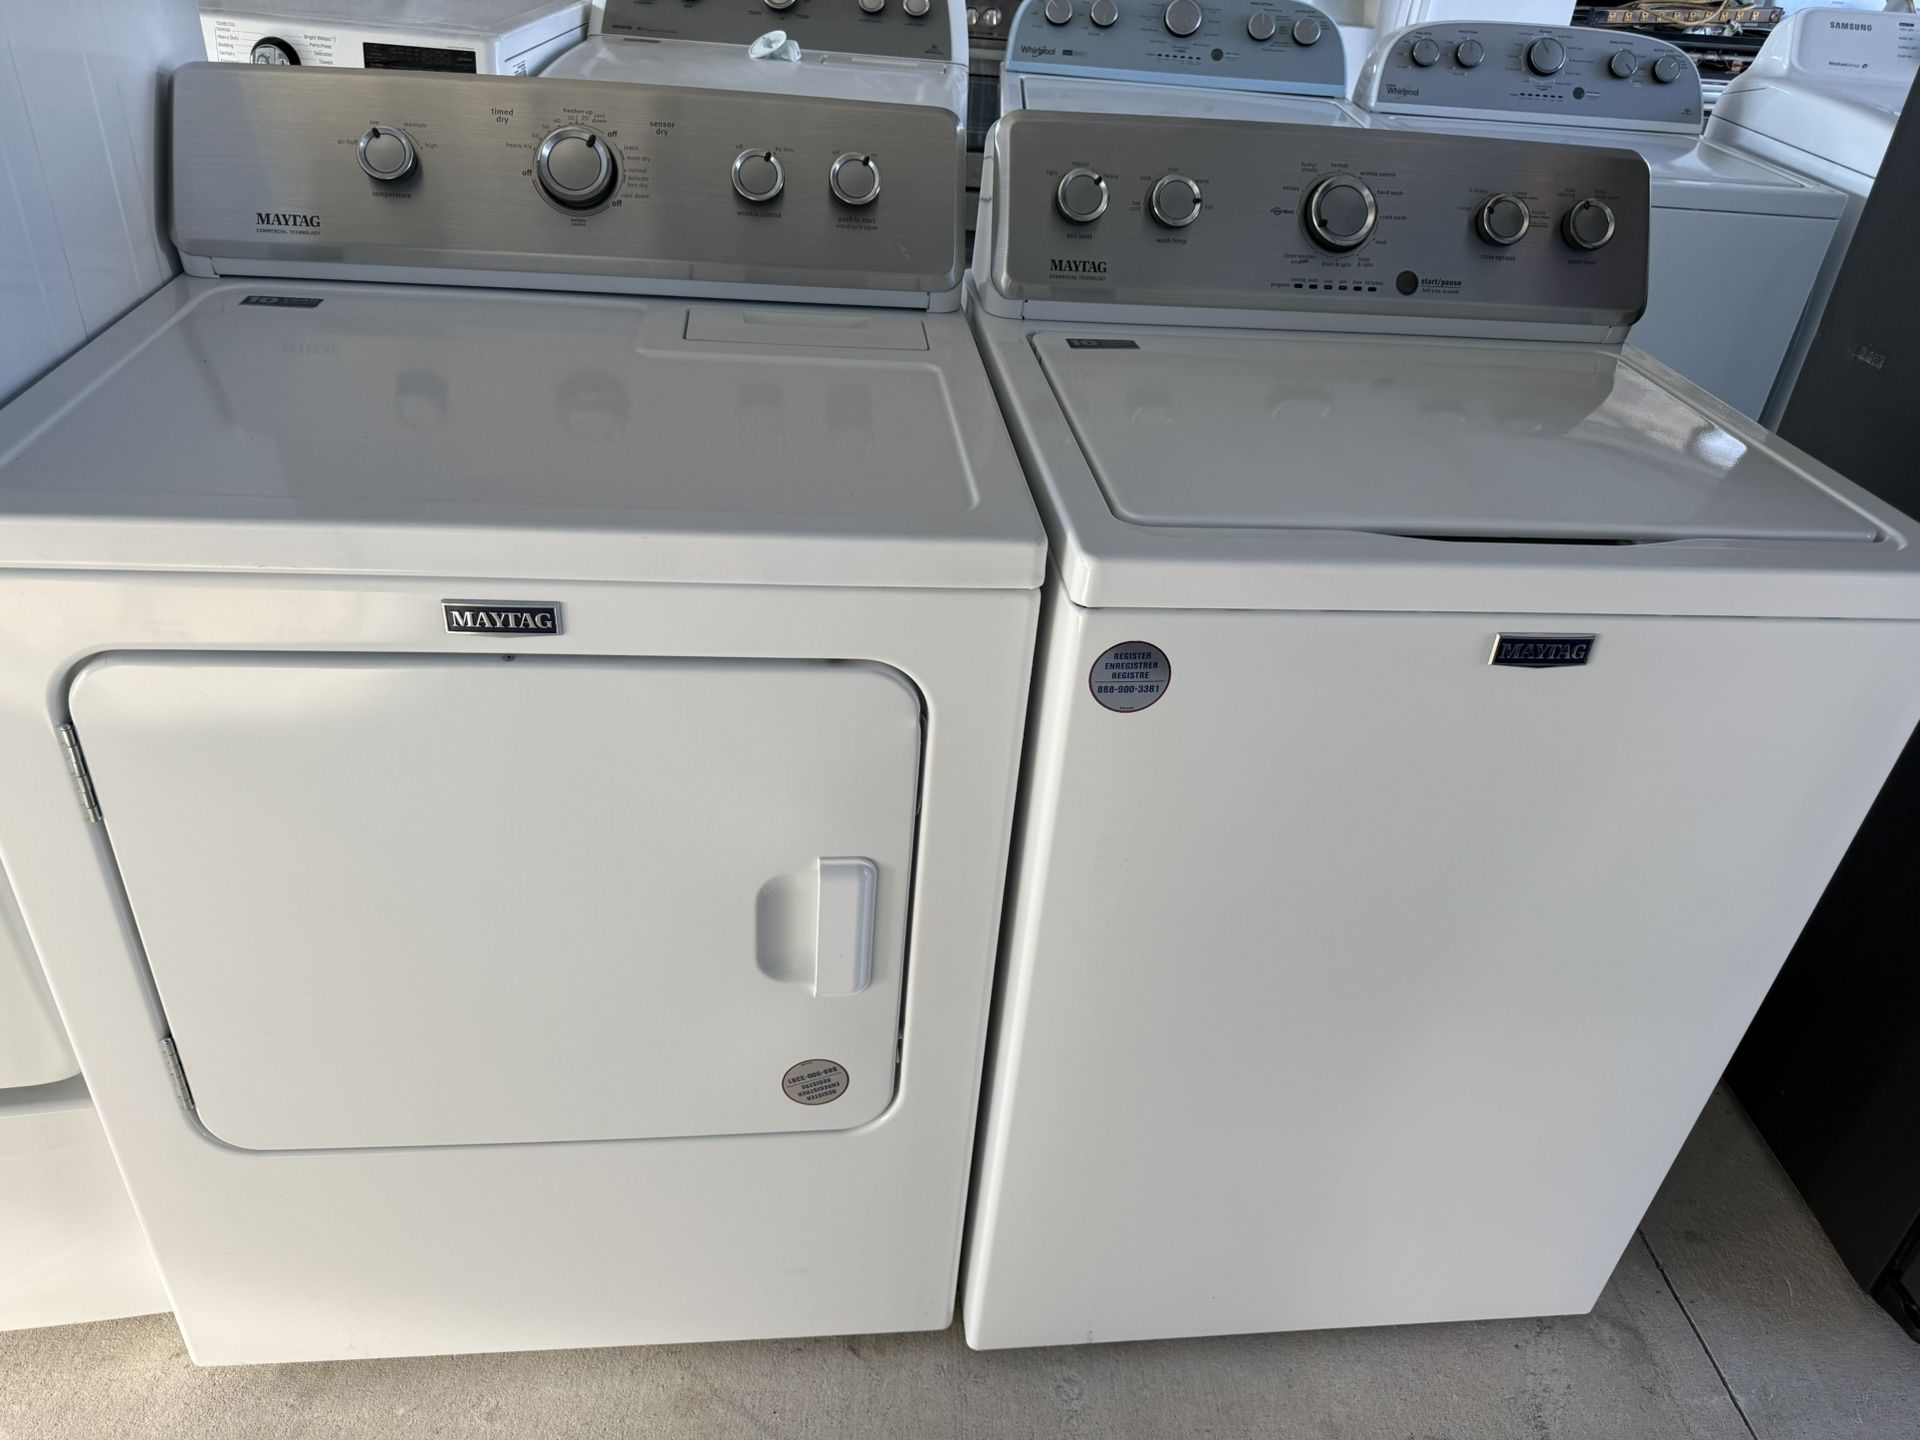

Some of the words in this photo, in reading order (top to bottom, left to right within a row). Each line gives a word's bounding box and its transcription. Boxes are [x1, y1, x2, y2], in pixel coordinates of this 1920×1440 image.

[1830, 21, 1872, 31] SAMSUNG
[1021, 45, 1056, 58] Whirlpool
[1387, 87, 1420, 97] Whirlpool
[492, 108, 514, 116] timed
[497, 116, 508, 125] dry
[656, 128, 668, 136] dry
[424, 143, 438, 151] high
[372, 191, 411, 200] temperature
[737, 210, 759, 218] wrinkle
[256, 212, 321, 228] MAYTAG
[1050, 259, 1107, 273] MAYTAG
[1421, 278, 1462, 287] start/pause
[450, 611, 552, 628] MAYTAG
[1498, 643, 1587, 659] MAYTAG
[1113, 652, 1152, 660] REGISTER
[1105, 662, 1158, 670] ENREGISTRER
[1111, 671, 1150, 679] REGISTRE
[1097, 685, 1159, 694] 888-900-3381
[788, 1066, 838, 1084] 888-900-3381
